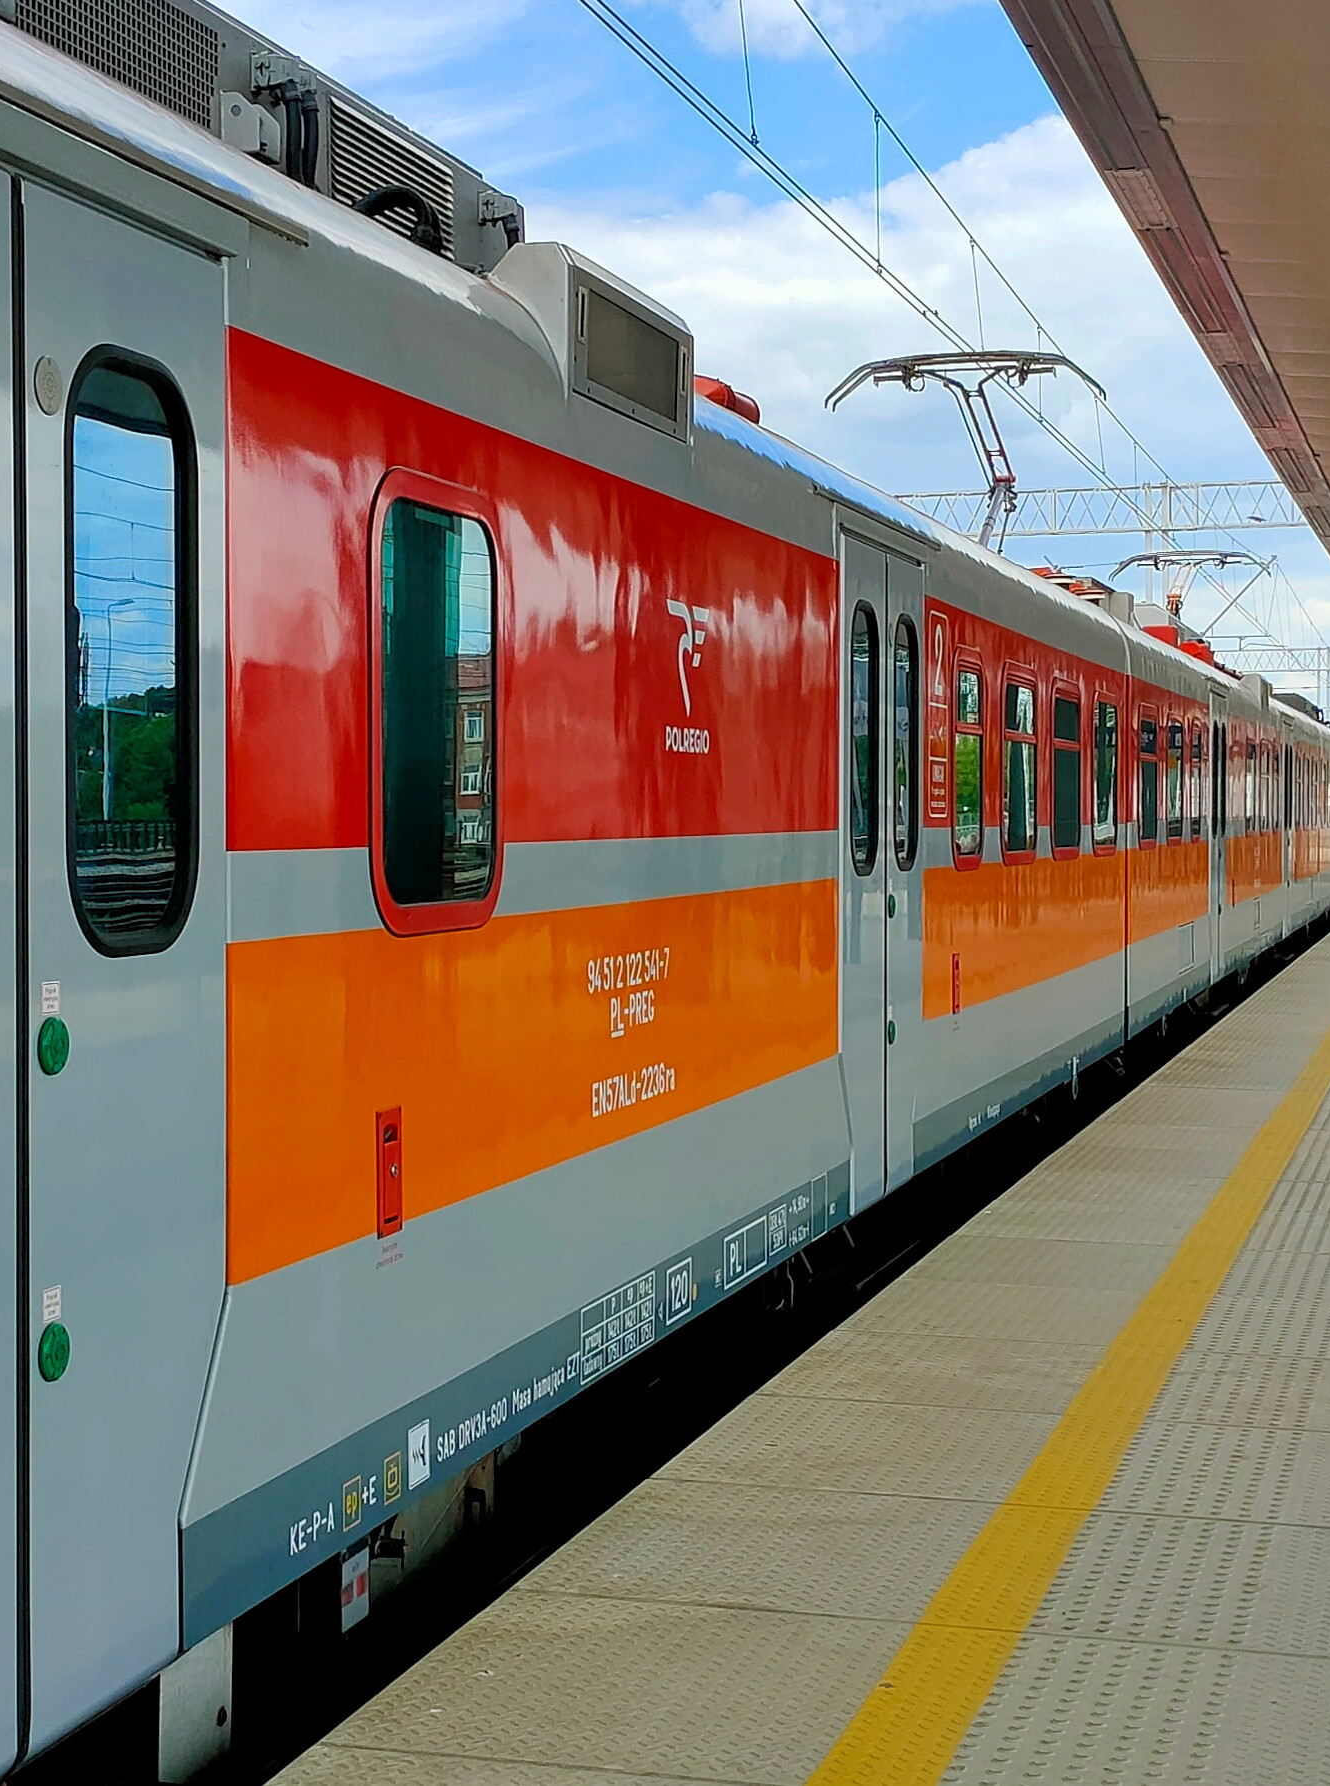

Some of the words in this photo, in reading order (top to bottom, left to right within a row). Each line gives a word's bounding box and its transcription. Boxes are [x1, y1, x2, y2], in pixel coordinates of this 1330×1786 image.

[934, 622, 944, 696] 2
[665, 725, 710, 755] POLREGIO
[587, 957, 601, 994] 94
[603, 956, 614, 990] 51
[616, 955, 624, 989] 2
[626, 951, 643, 987] 122
[644, 947, 670, 982] 541-7
[730, 1240, 742, 1277] PL
[670, 1270, 688, 1312] 120
[436, 1428, 456, 1462] SAB
[512, 1387, 532, 1416] Masa
[566, 1350, 581, 1381] EZT
[289, 1502, 335, 1556] KE-P-A
